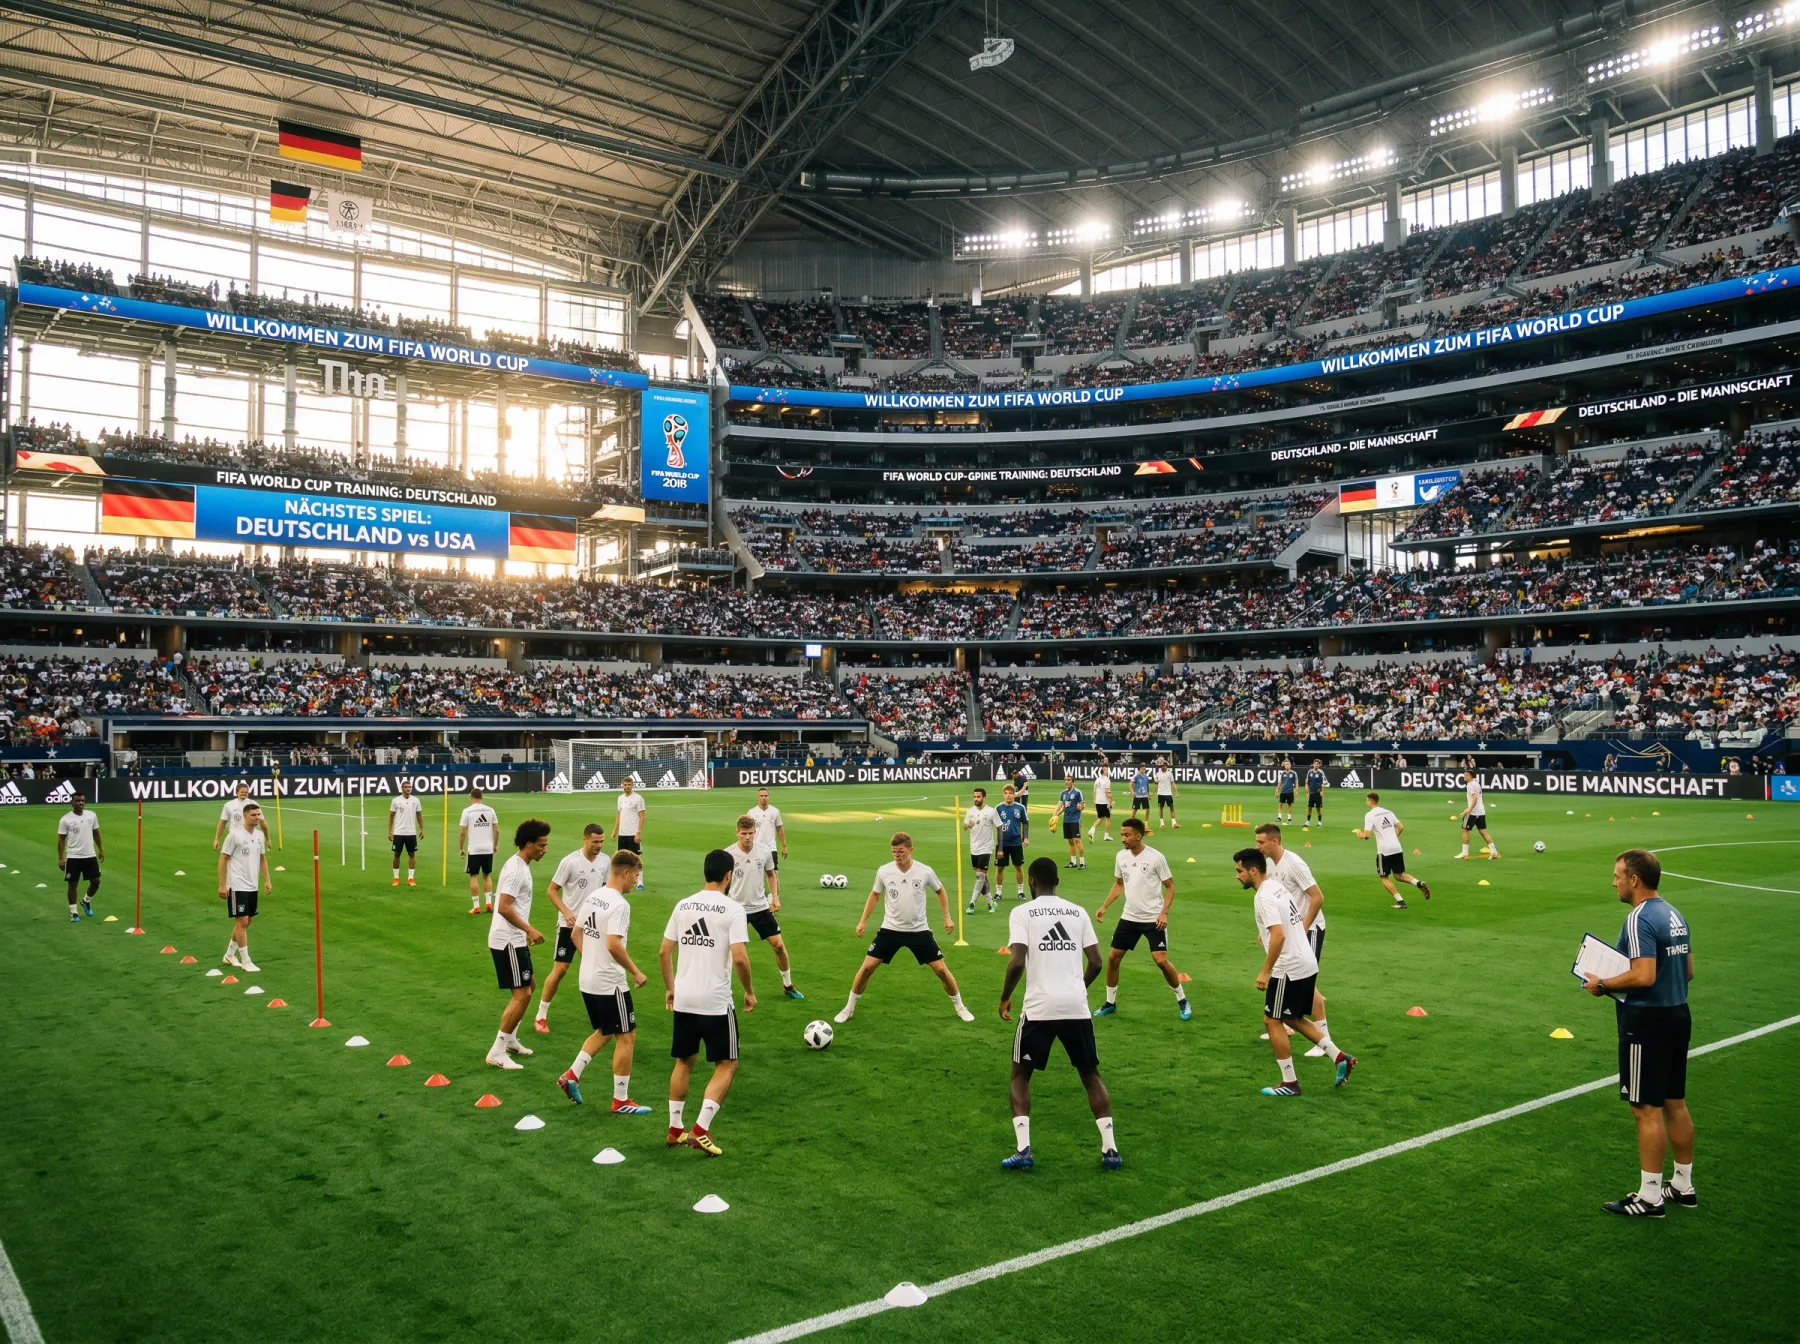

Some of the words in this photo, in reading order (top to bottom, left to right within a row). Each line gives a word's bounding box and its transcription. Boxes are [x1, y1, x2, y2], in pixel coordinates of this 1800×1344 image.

[206, 312, 338, 346] WILLKOMMEN
[343, 332, 384, 352] ZUM
[388, 339, 426, 358] FIFA
[429, 344, 492, 367] WORLD
[496, 355, 529, 371] CUP
[1321, 341, 1430, 374] WILLKOMMEN
[1434, 333, 1472, 353] ZUM
[1476, 327, 1513, 346] FIFA
[1516, 313, 1583, 339] WORLD
[1586, 304, 1624, 324] CUP
[864, 393, 965, 408] WILLKOMMEN
[968, 394, 1000, 407] ZUM
[1004, 393, 1035, 406] FIFA
[1037, 390, 1091, 405] WORLD
[1094, 387, 1124, 402] CUP
[1578, 394, 1667, 418] DEUTSCHLAND
[1677, 389, 1698, 404] DIE
[1700, 374, 1793, 399] MANNSCHAFT
[1271, 443, 1341, 461] DEUTSCHLAND
[1349, 440, 1366, 451] DIE
[1367, 429, 1438, 449] MANNSCHAFT
[883, 471, 905, 482] FIFA
[906, 471, 942, 482] WORLD
[999, 469, 1048, 481] TRAINING:
[1050, 466, 1121, 479] DEUTSCHLAND
[216, 471, 247, 485] FIFA
[249, 473, 302, 490] WORLD
[304, 479, 332, 492] CUP
[335, 481, 402, 499] TRAINING:
[405, 488, 497, 507] DEUTSCHLAND
[285, 497, 377, 521] NÄCHSTES
[381, 507, 432, 525] SPIEL:
[236, 516, 403, 545] DEUTSCHLAND
[407, 533, 429, 547] vs
[435, 530, 476, 550] USA
[294, 777, 341, 796] ZUM
[347, 776, 391, 794] FIFA
[394, 774, 467, 793] WORLD
[472, 774, 511, 791] CUP
[739, 768, 845, 785] DEUTSCHLAND
[858, 767, 880, 782] DIE
[882, 766, 972, 781] MANNSCHAFT
[1175, 768, 1201, 782] FIFA
[1204, 768, 1254, 783] WORLD
[1546, 775, 1577, 792] DIE
[1582, 775, 1728, 796] MANNSCHAFT
[1029, 907, 1080, 918] DEUTSCHLAND
[681, 935, 715, 948] adidas
[1038, 939, 1077, 951] adidas
